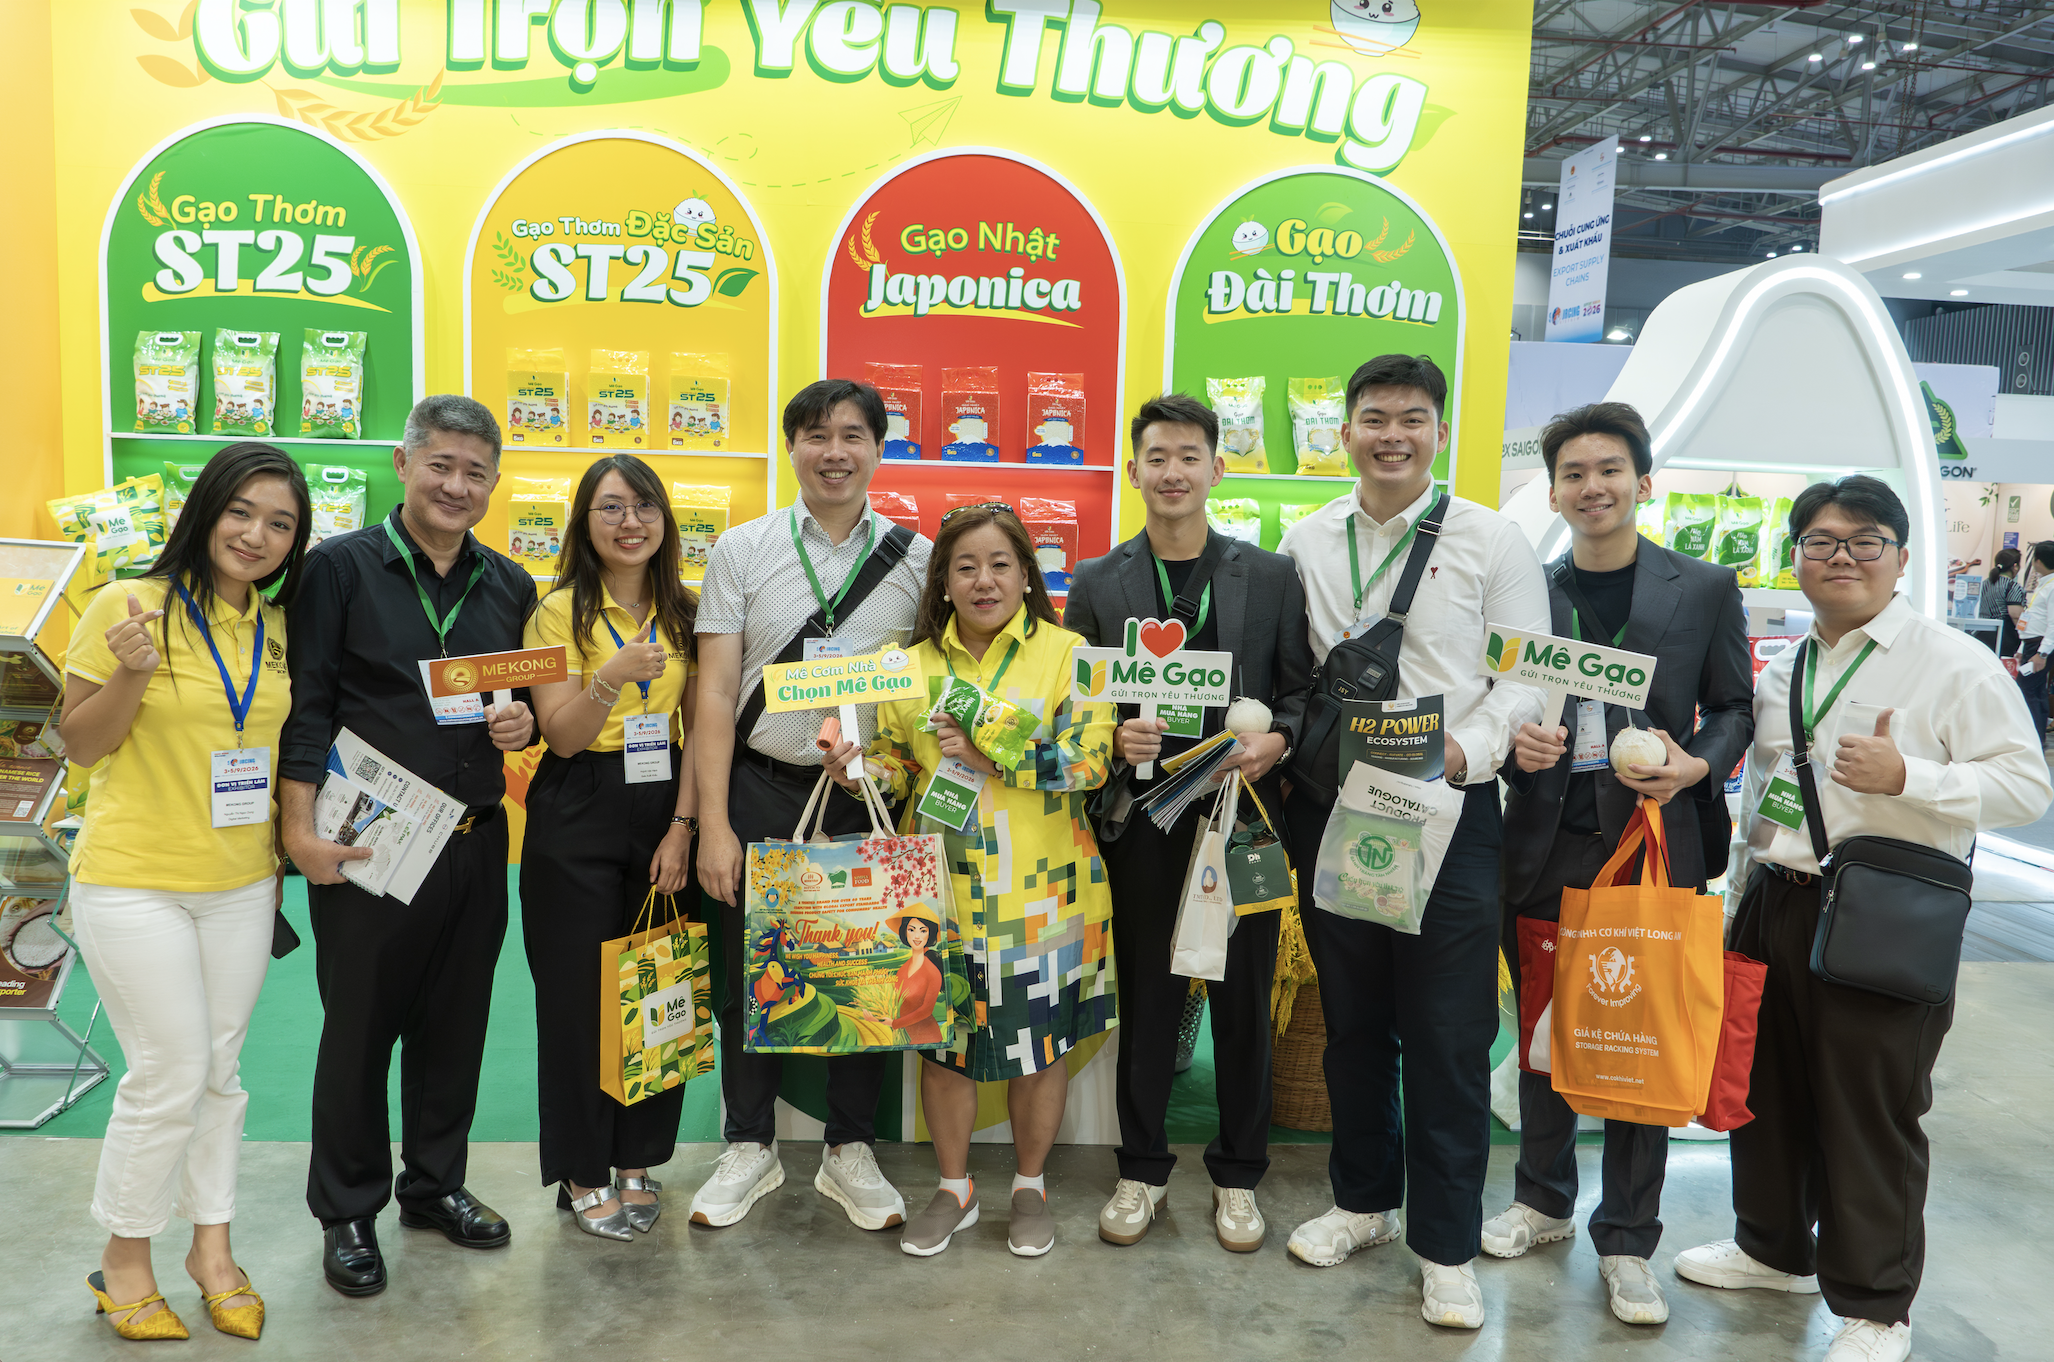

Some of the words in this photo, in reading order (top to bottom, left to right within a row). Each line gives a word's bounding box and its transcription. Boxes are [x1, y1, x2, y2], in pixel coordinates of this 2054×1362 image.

[990, 0, 1430, 175] Thương
[170, 194, 239, 224] Gạo
[247, 194, 347, 229] Thơm
[1554, 224, 1576, 241] CHUỖI
[1576, 219, 1595, 235] CUNG
[1595, 214, 1610, 227] ỨNG
[511, 219, 554, 241] Gạo
[558, 216, 621, 237] Thơm
[625, 209, 689, 248] Đặc
[694, 222, 754, 261] Sản
[900, 224, 970, 256] Gạo
[977, 221, 1061, 262] Nhật
[1274, 217, 1365, 267] Gạo
[1558, 246, 1564, 255] &
[152, 229, 358, 297] ST25
[1553, 262, 1579, 278] EXPORT
[1579, 253, 1605, 270] SUPPLY
[529, 243, 717, 308] ST25
[1565, 272, 1590, 287] CHAINS
[867, 263, 1082, 318] Japonica
[1206, 267, 1295, 317] Đài
[1303, 269, 1444, 324] Thơm
[139, 364, 186, 377] ST25
[217, 366, 262, 378] ST25
[306, 365, 352, 378] ST25
[518, 387, 554, 397] ST25
[599, 389, 635, 399] ST25
[679, 392, 716, 402] ST25
[955, 406, 986, 415] JAPONICA
[1041, 408, 1072, 418] JAPONICA
[108, 516, 126, 528] Mê
[518, 517, 554, 527] ST25
[679, 523, 715, 533] ST25
[1946, 520, 1970, 534] Life
[111, 526, 129, 534] Gạo
[1034, 535, 1064, 545] JAPONICA
[1125, 620, 1138, 658] I
[482, 656, 557, 677] MEKONG
[786, 667, 808, 681] Mê
[812, 665, 844, 678] Cơm
[847, 659, 877, 674] Nhà
[1523, 640, 1571, 671] Mê
[1577, 652, 1647, 687] Gạo
[505, 673, 536, 683] GROUP
[1111, 659, 1157, 685] Mê
[1162, 662, 1226, 692] Gạo
[776, 684, 832, 703] Chọn
[835, 676, 868, 697] Mê
[870, 674, 913, 693] Gạo
[1520, 668, 1539, 679] GỬI
[1541, 672, 1570, 686] TRỌN
[1572, 678, 1594, 691] YÊU
[1597, 684, 1642, 702] THƯƠNG
[1110, 688, 1128, 698] GỬI
[1131, 690, 1158, 700] TRỌN
[1161, 691, 1180, 700] YÊU
[1183, 692, 1225, 702] THƯƠNG
[1159, 709, 1176, 717] MUA
[1166, 716, 1190, 725] BUYER
[1349, 716, 1377, 734] H2
[1379, 712, 1440, 736] POWER
[1366, 735, 1428, 746] ECOSYSTEM
[224, 766, 259, 775] 3-5/9/2026
[396, 780, 411, 804] CONTACT
[930, 790, 946, 802] MUA
[1768, 792, 1783, 803] MUA
[935, 800, 958, 813] BUYER
[1367, 784, 1439, 817] CATALOGUE
[439, 802, 448, 814] OUR
[1369, 799, 1428, 827] PRODUCT
[1771, 801, 1795, 815] BUYER
[426, 812, 441, 834] OFFICES
[1246, 853, 1261, 862] Dh
[794, 918, 843, 946] Thank
[843, 921, 881, 947] you!
[1598, 927, 1613, 938] CƠ
[1613, 926, 1627, 938] KHÍ
[1627, 926, 1646, 940] VIỆT
[1647, 929, 1674, 941] LONG
[817, 960, 835, 968] HEALTH
[846, 958, 868, 967] SUCCESS
[808, 970, 825, 979] CHÚNG
[833, 970, 847, 978] CHÚC
[885, 974, 899, 984] CÔNG
[1585, 983, 1609, 1007] Forever
[1609, 983, 1643, 1009] Improving
[666, 995, 686, 1014] Mê
[667, 1009, 687, 1022] Gạo
[1573, 1026, 1590, 1038] GIÁ
[1591, 1028, 1603, 1042] KỆ
[1603, 1029, 1631, 1042] CHỨA
[1632, 1031, 1658, 1045] HÀNG
[1575, 1041, 1604, 1052] STORAGE
[1604, 1044, 1634, 1054] RACKING
[1634, 1047, 1659, 1057] SYSTEM
[1595, 1074, 1645, 1085] www.cokhiviet.net
